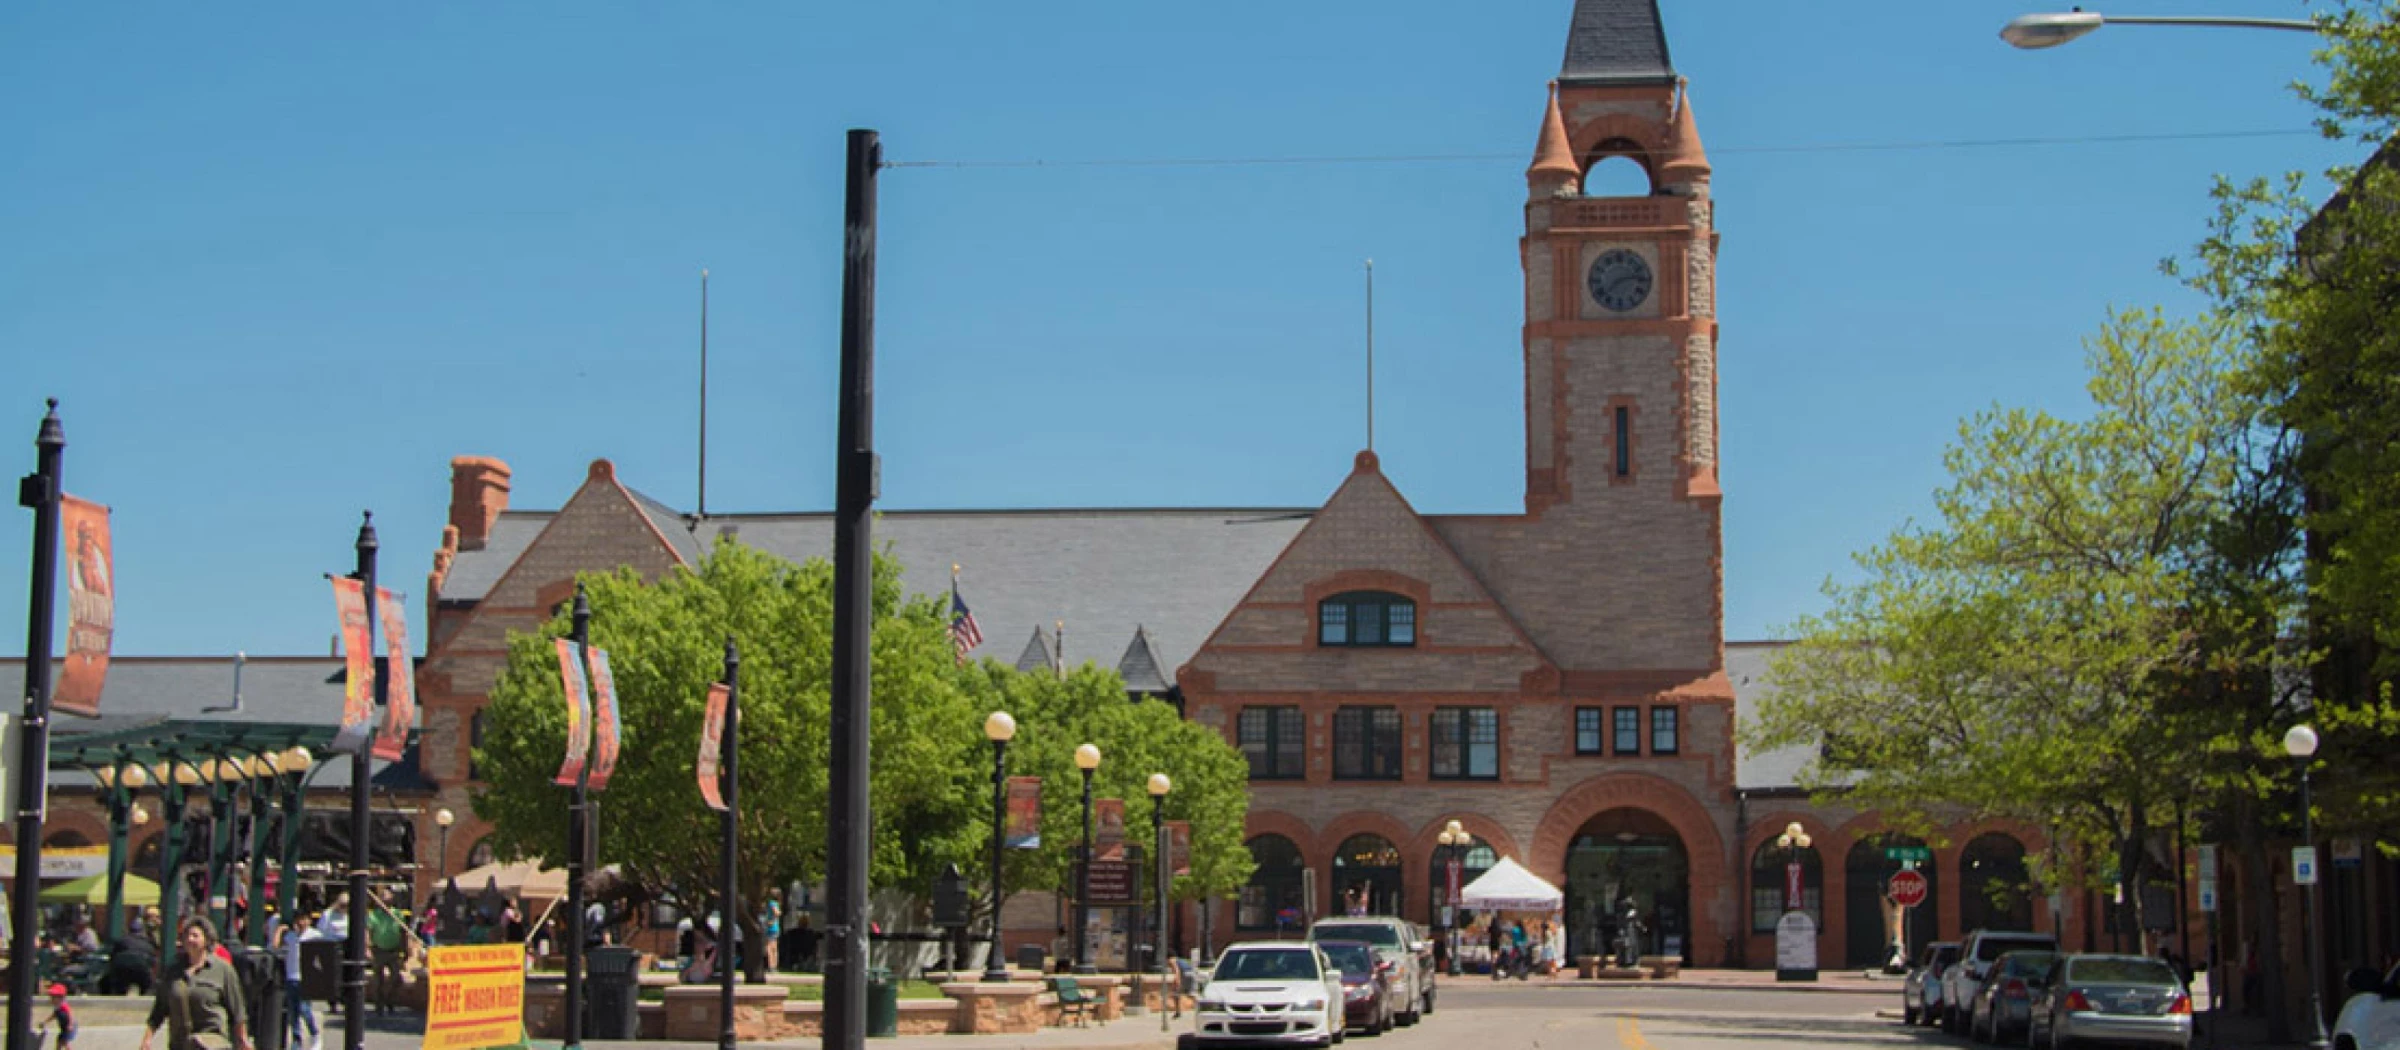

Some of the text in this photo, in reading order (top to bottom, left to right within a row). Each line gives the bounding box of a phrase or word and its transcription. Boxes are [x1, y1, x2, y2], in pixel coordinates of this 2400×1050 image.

[1891, 880, 1924, 896] STOP
[434, 982, 462, 1014] FREE
[465, 987, 495, 1011] WAGON
